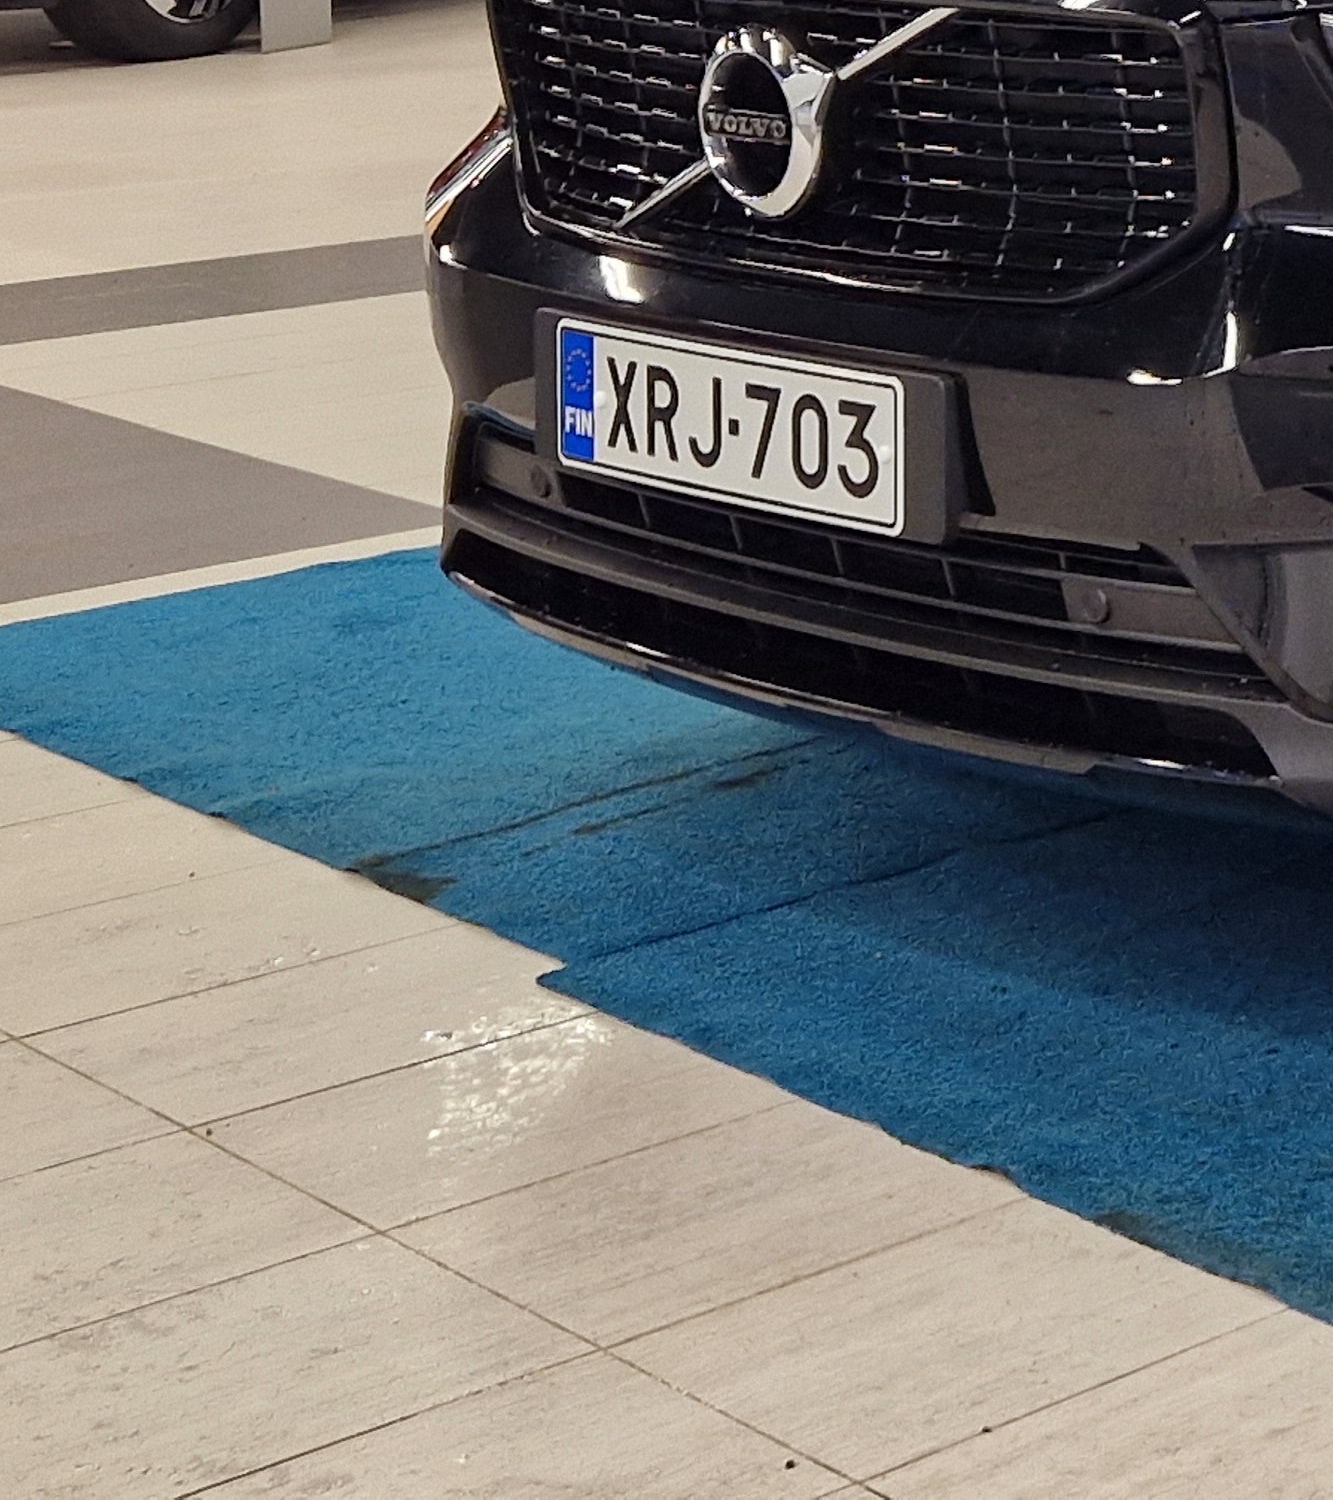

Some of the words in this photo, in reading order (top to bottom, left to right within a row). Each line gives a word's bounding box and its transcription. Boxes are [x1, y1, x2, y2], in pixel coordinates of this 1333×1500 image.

[706, 111, 787, 139] VOLVO
[564, 405, 594, 438] FIN
[606, 356, 879, 499] XRJ-703
